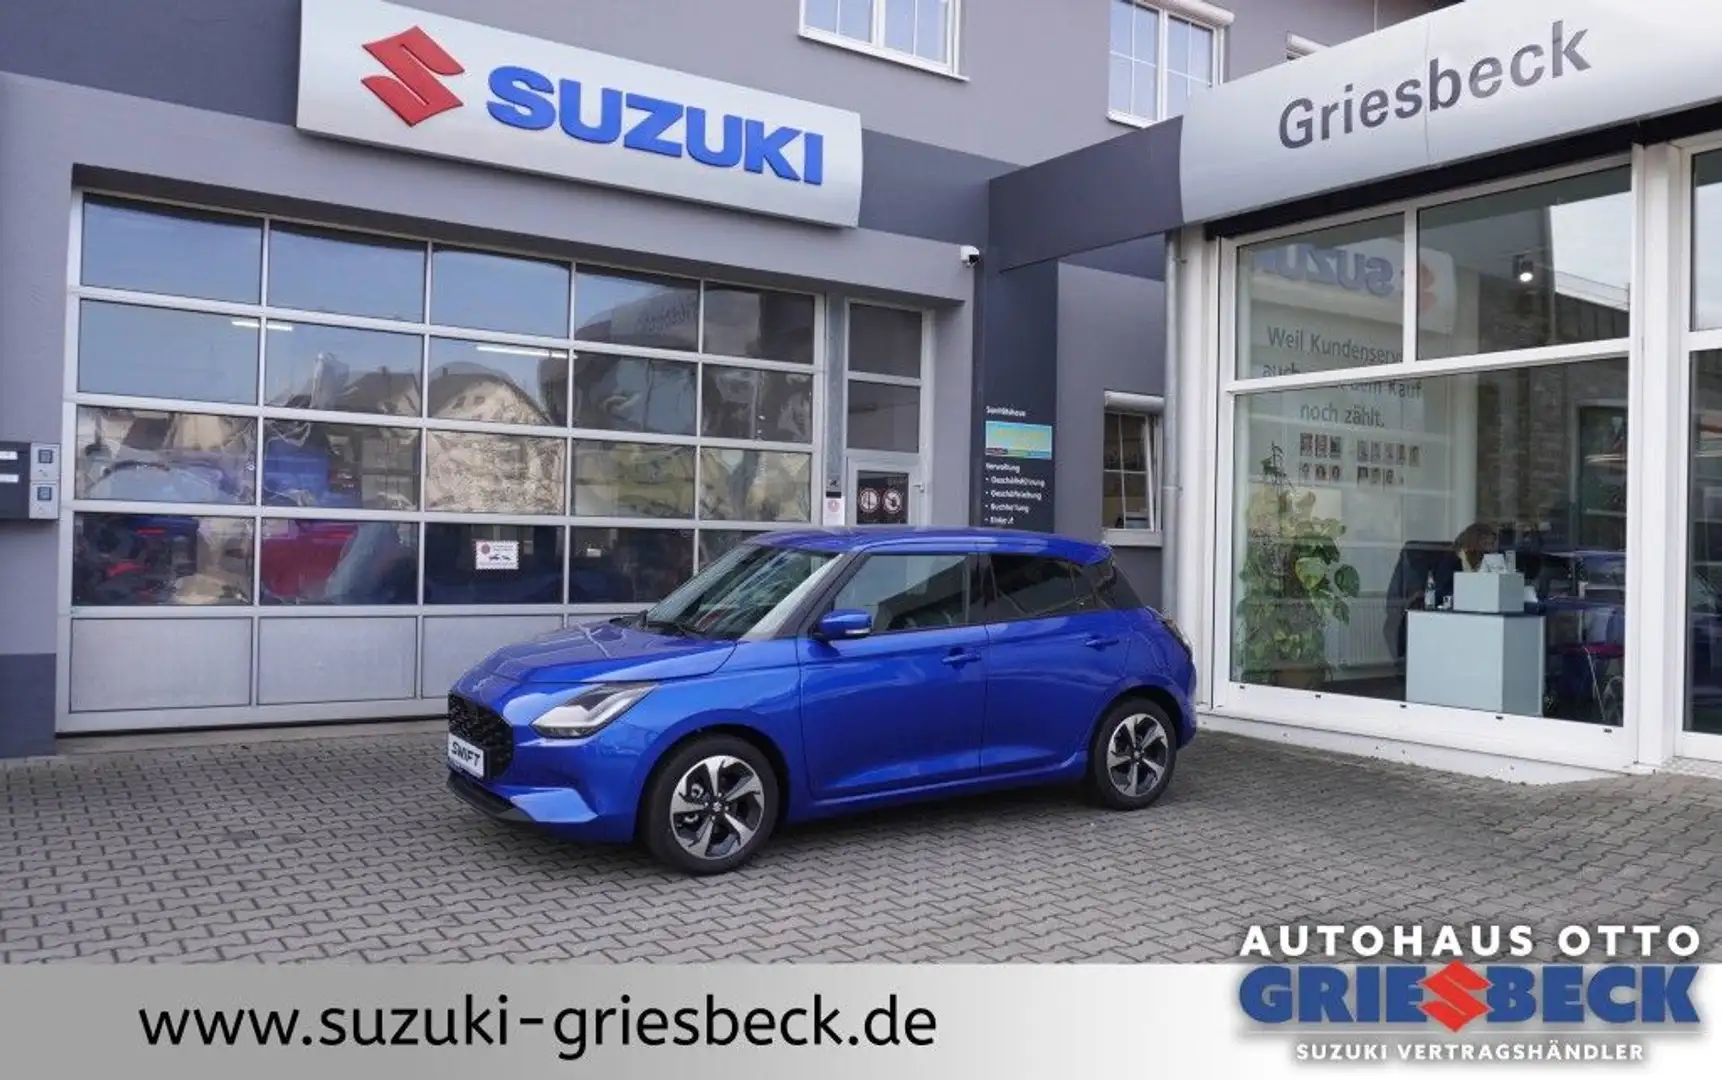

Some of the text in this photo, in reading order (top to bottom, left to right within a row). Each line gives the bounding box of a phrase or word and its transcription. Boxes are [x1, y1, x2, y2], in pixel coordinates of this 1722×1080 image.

[1278, 20, 1592, 149] Griesbeck
[486, 66, 823, 185] SUZUKI
[1267, 326, 1404, 363] Weil Kundenserv
[1300, 402, 1385, 427] noch zählt.
[452, 741, 480, 767] SWIFT
